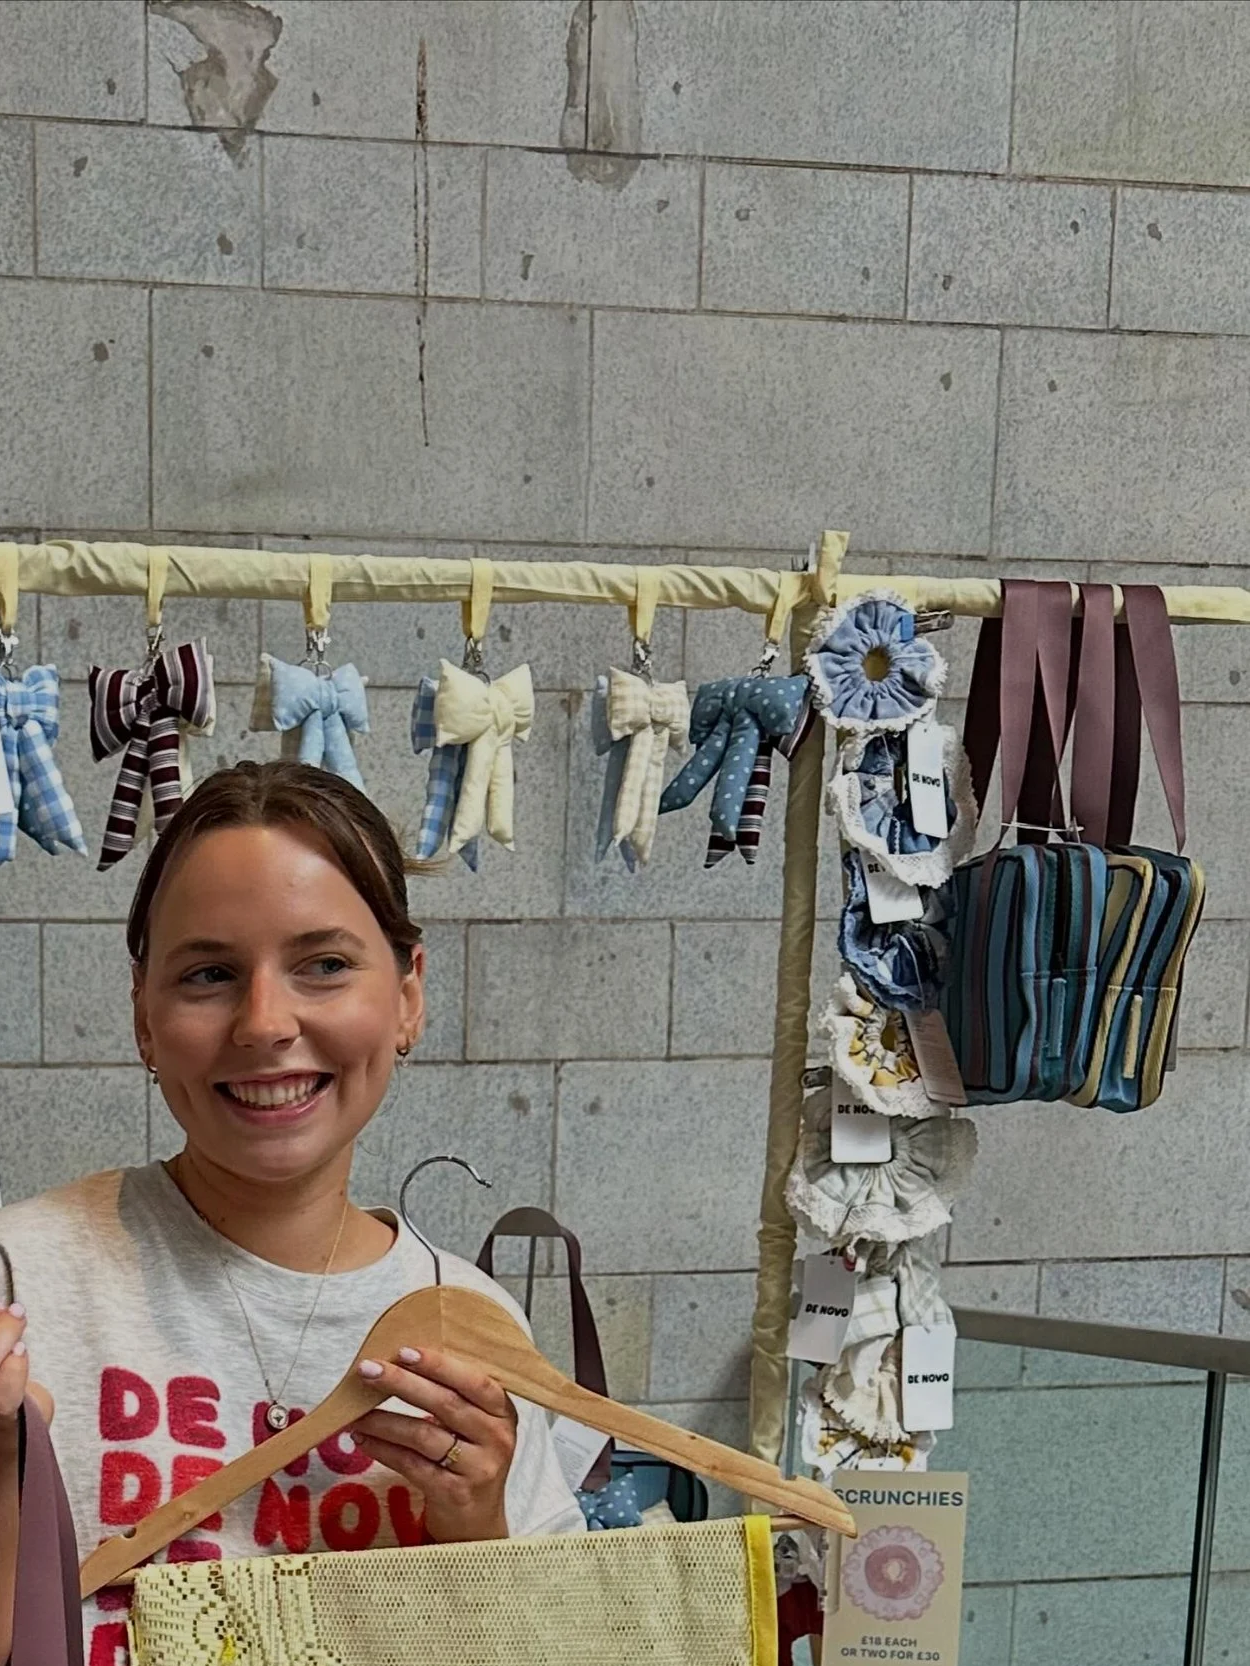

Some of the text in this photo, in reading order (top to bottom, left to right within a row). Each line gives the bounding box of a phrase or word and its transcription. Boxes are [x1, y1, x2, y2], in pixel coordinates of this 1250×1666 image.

[922, 775, 941, 787] NOVO
[838, 1104, 851, 1114] DE
[805, 1303, 849, 1317] DE NOVO
[907, 1373, 949, 1384] DE NOVO
[99, 1366, 227, 1450] DE
[253, 1477, 428, 1555] NOV
[861, 1635, 917, 1648] £18 EACH
[840, 1647, 940, 1661] OR TWO FOR £30
